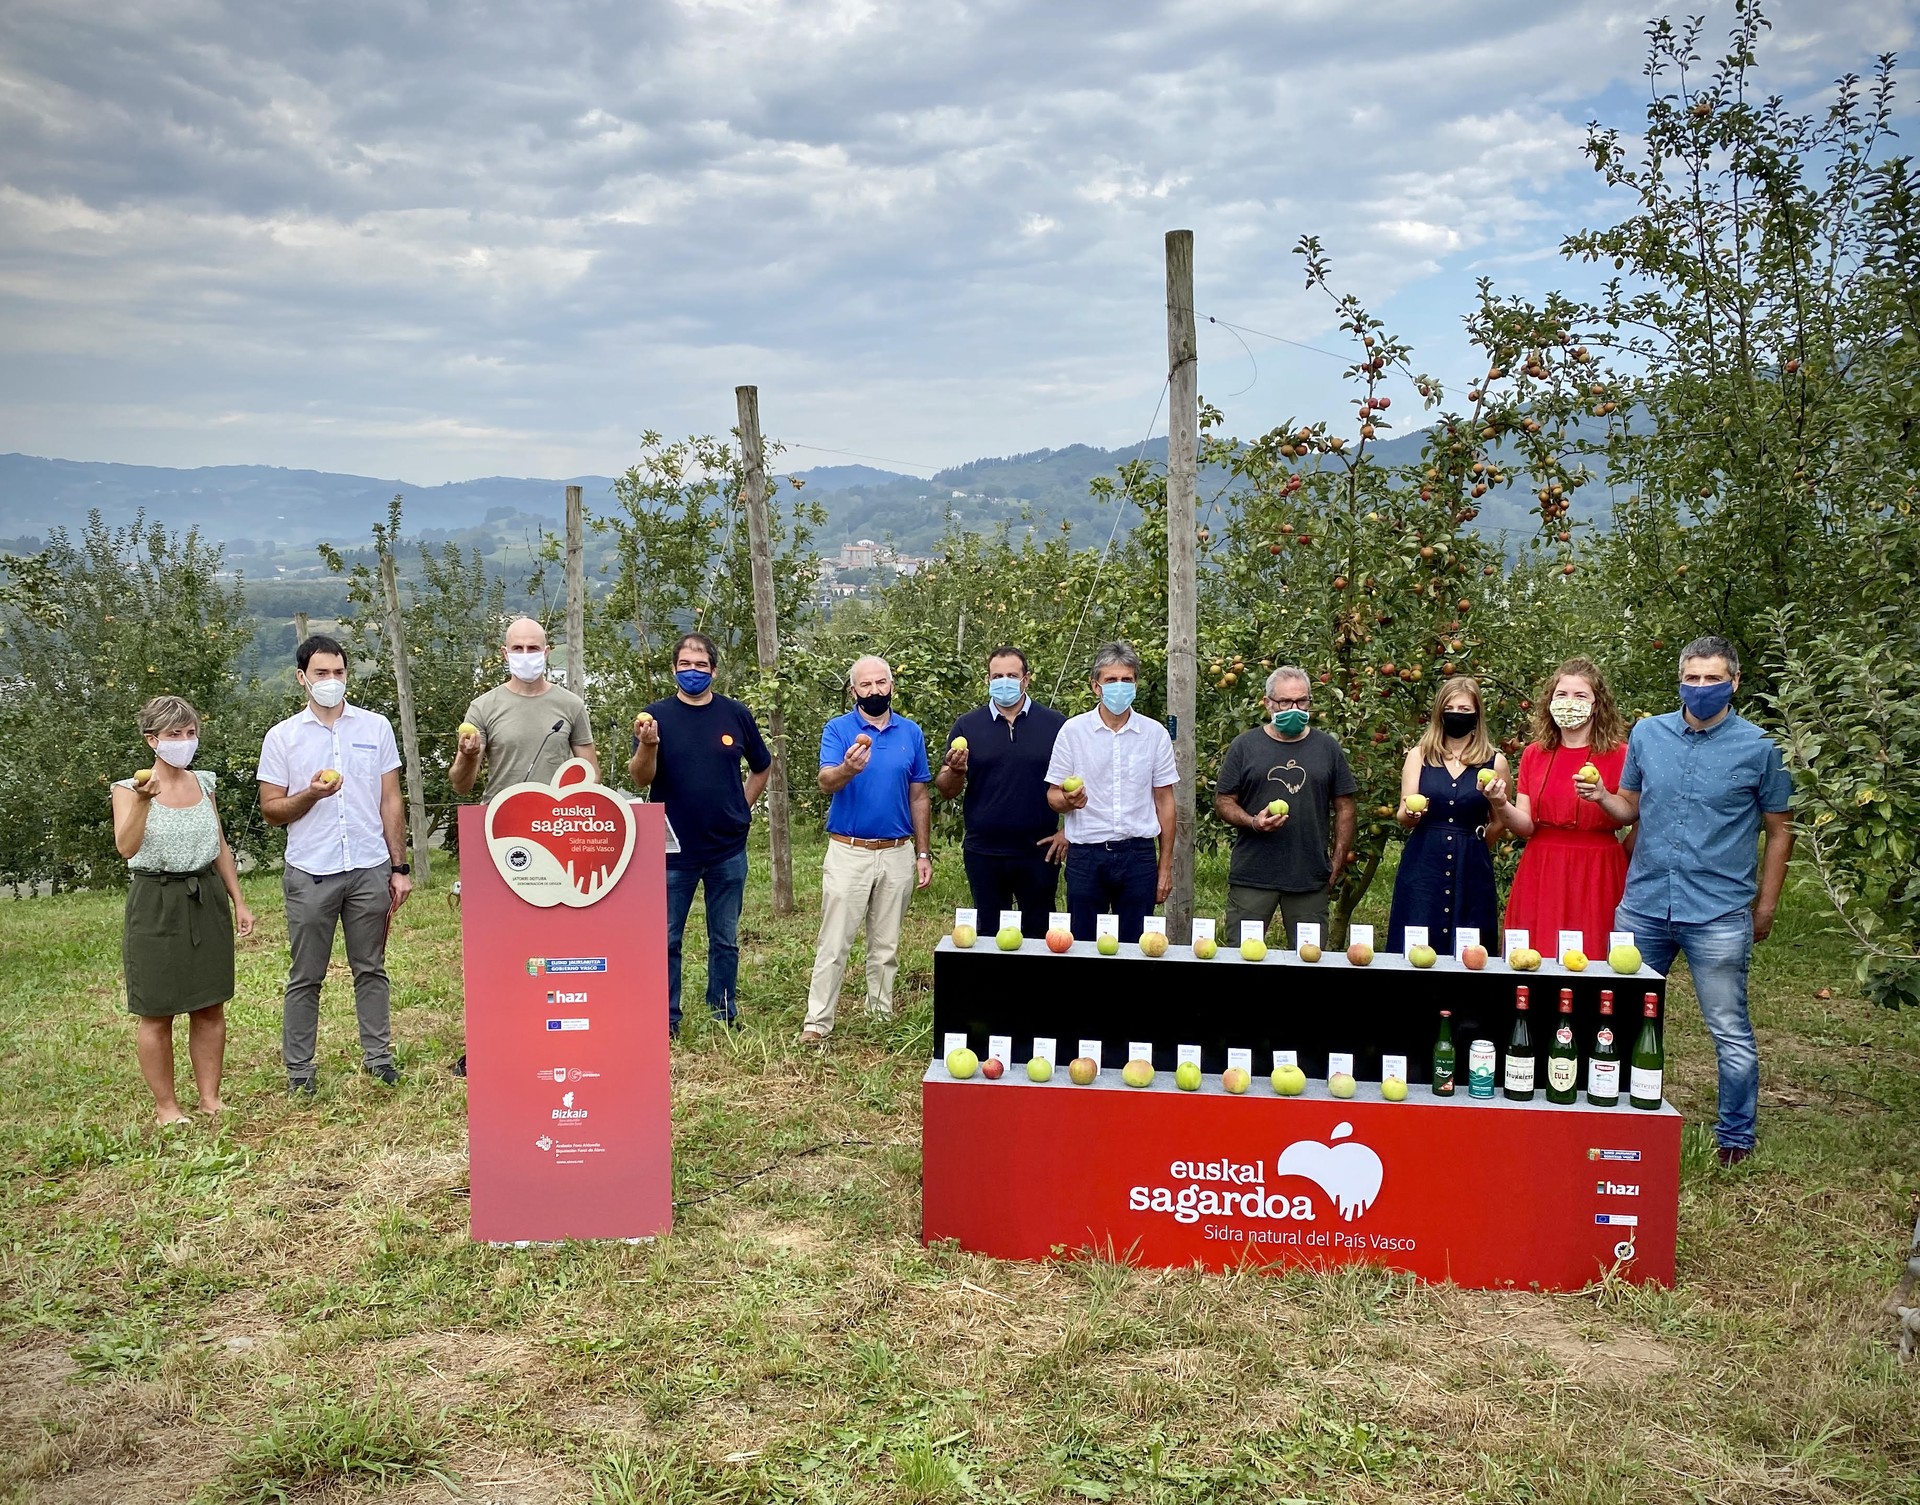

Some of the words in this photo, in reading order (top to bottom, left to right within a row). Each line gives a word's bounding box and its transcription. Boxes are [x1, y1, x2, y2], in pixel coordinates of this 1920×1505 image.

[552, 805, 596, 817] euskal
[531, 818, 616, 836] sagardoa
[556, 990, 588, 1003] hazi
[552, 1108, 588, 1119] Bizkaia
[1170, 1158, 1265, 1185] euskal
[1606, 1181, 1639, 1196] hazi
[1129, 1184, 1316, 1223] sagardoa
[1204, 1224, 1244, 1242] Sidra
[1248, 1229, 1301, 1246] natural
[1306, 1230, 1330, 1246] del
[1335, 1232, 1366, 1249] País
[1370, 1234, 1416, 1251] Vasco
